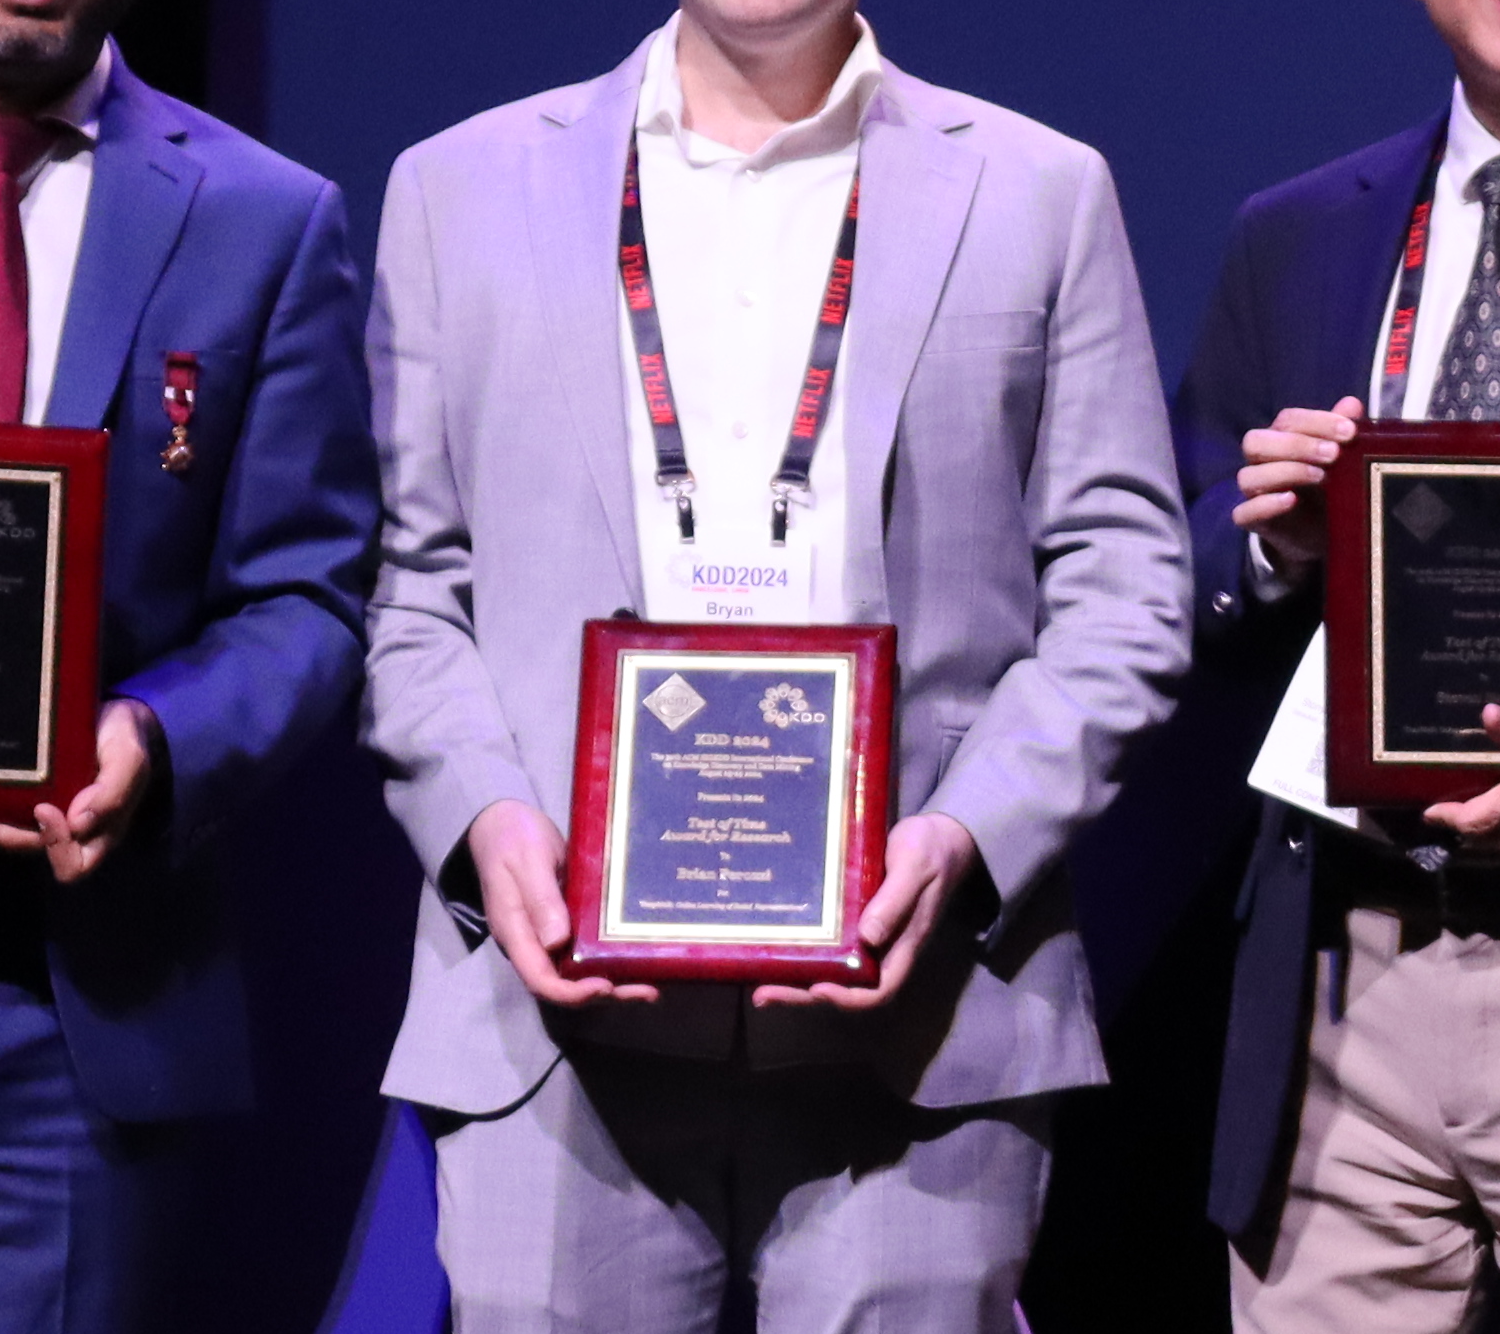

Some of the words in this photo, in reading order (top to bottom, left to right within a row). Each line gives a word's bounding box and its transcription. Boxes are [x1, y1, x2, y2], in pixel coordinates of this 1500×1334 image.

[621, 245, 654, 310] NETFLIX
[820, 257, 854, 325] NETFLIX
[1385, 307, 1416, 374] NETFLIX
[639, 353, 677, 425] NETFLIX
[792, 366, 832, 437] NETFLIX
[693, 565, 788, 587] KDD2024
[706, 602, 753, 619] Bryan
[789, 712, 826, 723] KDD
[694, 733, 731, 746] KDD
[733, 735, 771, 749] 2024
[688, 817, 716, 829] Test
[716, 817, 734, 831] of
[733, 818, 767, 830] Time
[660, 829, 707, 842] Award
[705, 829, 729, 844] for
[729, 830, 792, 844] Research
